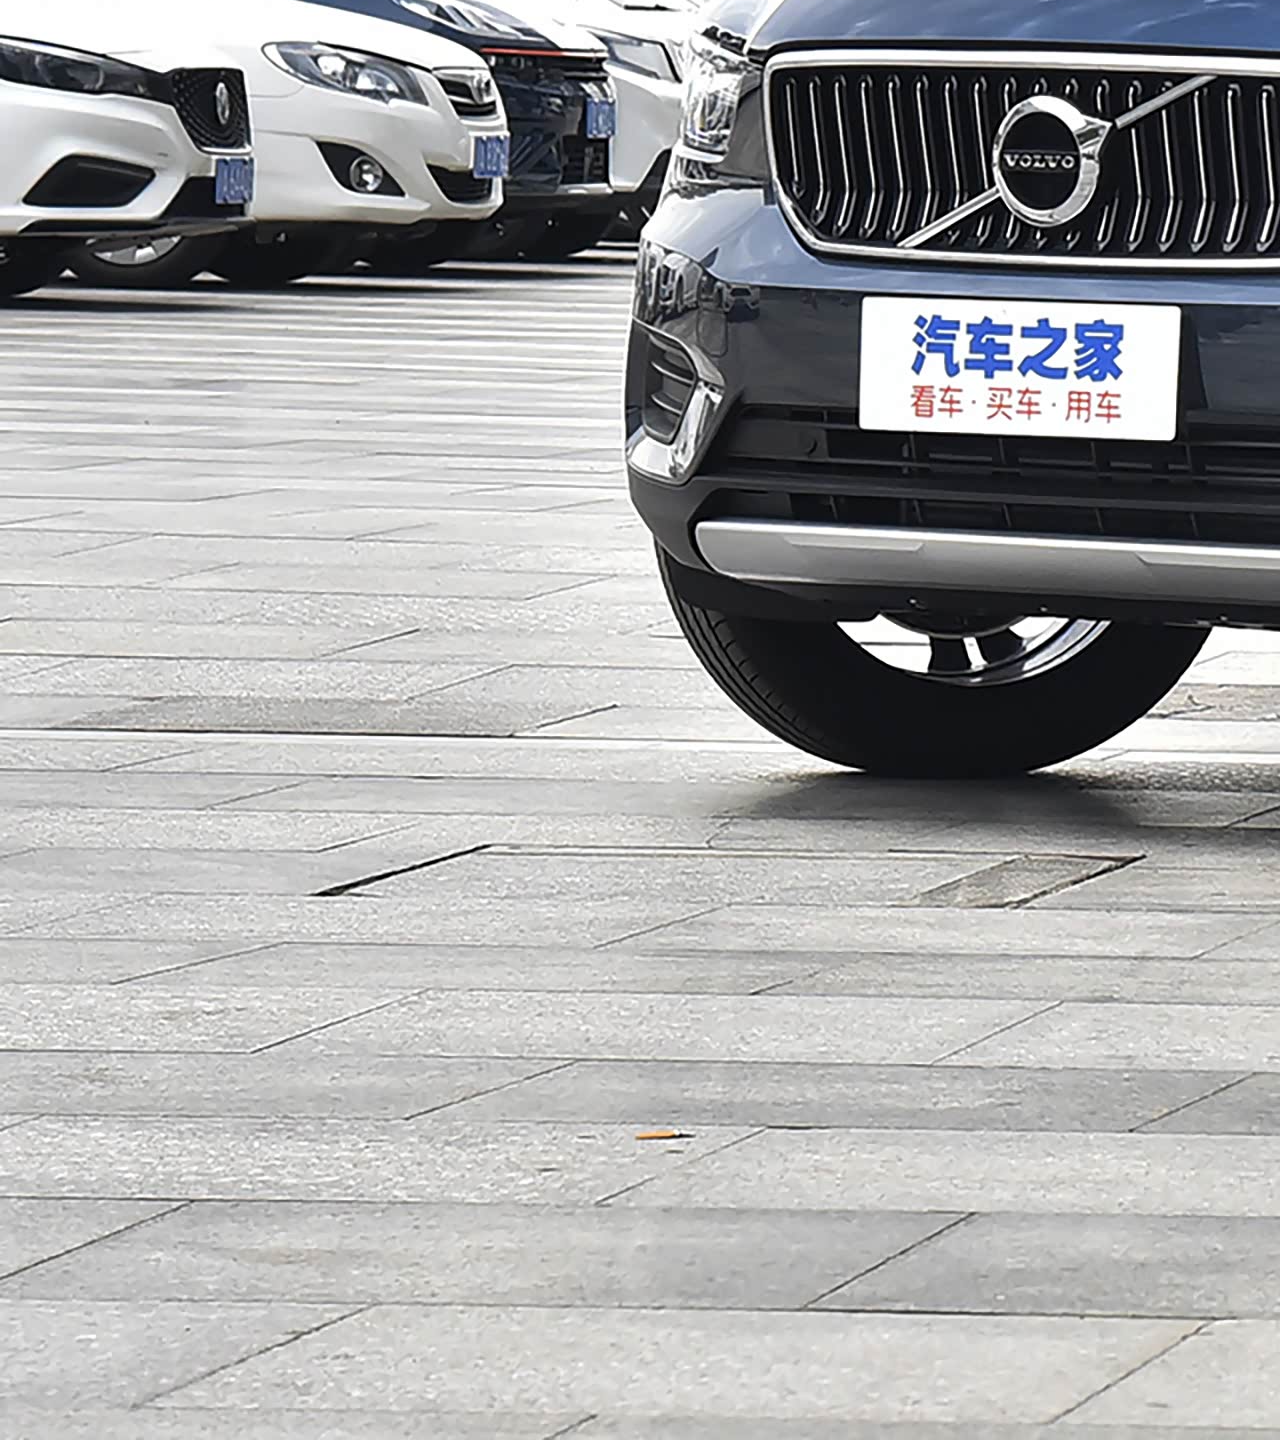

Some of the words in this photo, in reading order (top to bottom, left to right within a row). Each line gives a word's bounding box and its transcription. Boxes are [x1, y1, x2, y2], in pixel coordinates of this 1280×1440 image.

[1003, 153, 1075, 169] VOLVO
[912, 315, 1124, 382] 汽车之家
[911, 385, 1121, 424] 看车·买车·用车
